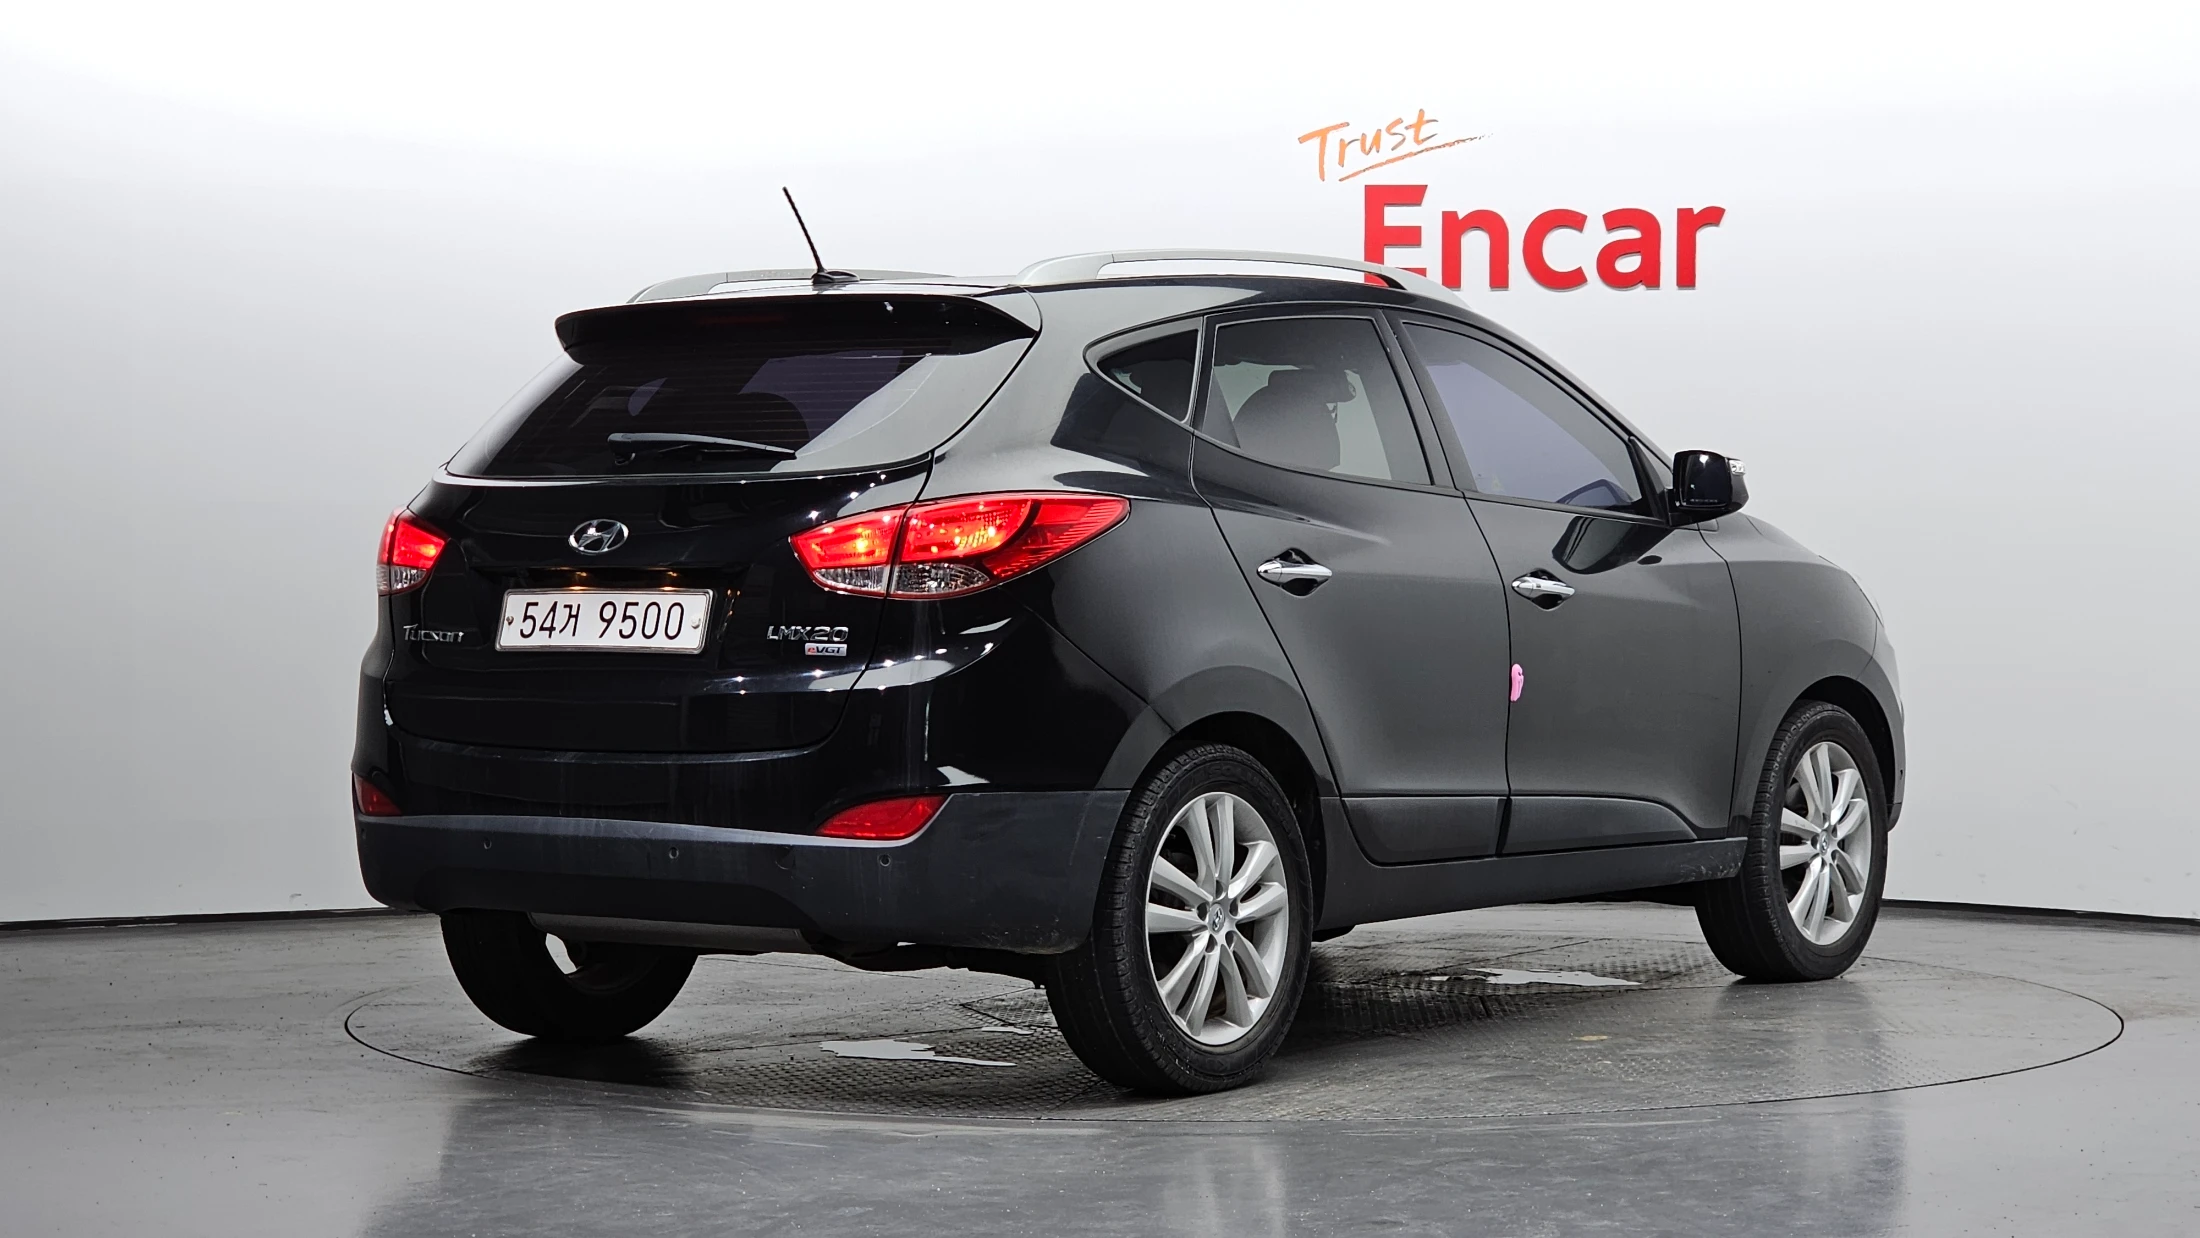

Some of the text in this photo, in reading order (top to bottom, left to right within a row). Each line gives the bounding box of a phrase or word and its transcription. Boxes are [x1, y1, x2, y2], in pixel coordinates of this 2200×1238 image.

[1298, 108, 1440, 182] Trust
[1364, 184, 1727, 291] Encar
[519, 600, 685, 641] 54거 9500
[766, 625, 849, 642] LMX20
[806, 645, 845, 655] eVGT
